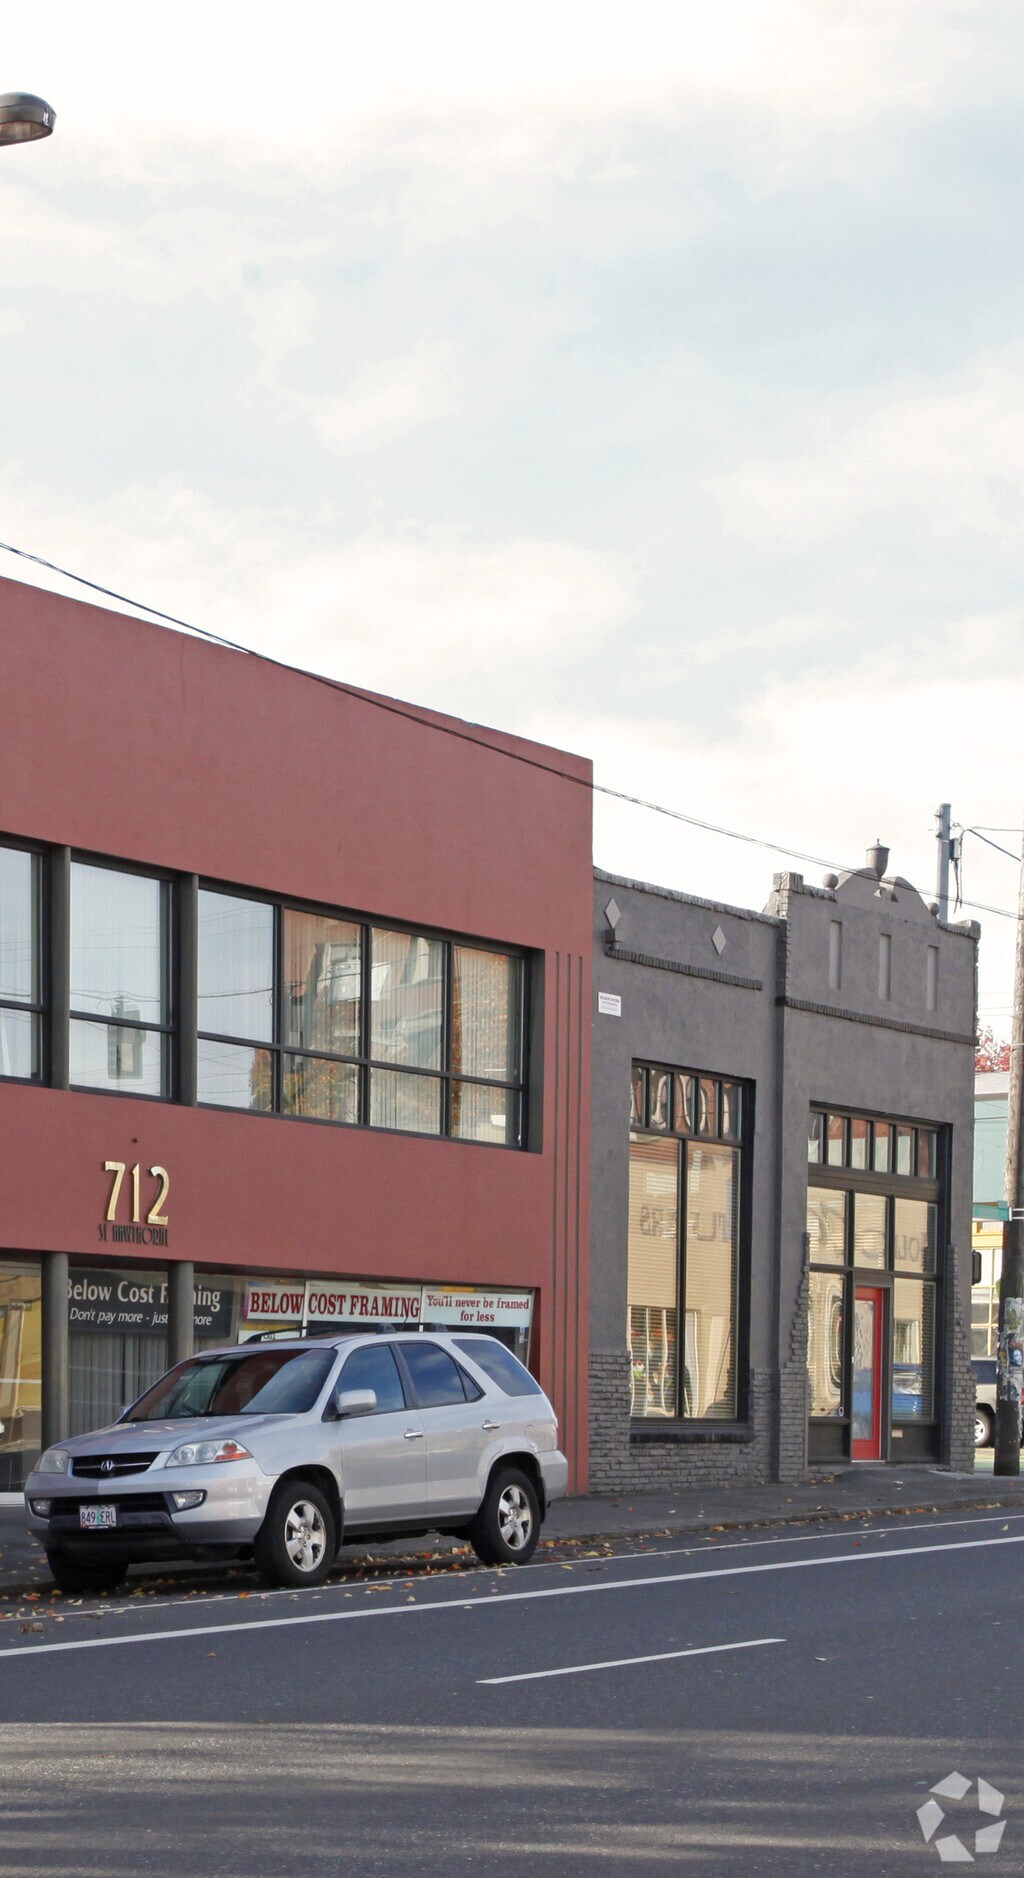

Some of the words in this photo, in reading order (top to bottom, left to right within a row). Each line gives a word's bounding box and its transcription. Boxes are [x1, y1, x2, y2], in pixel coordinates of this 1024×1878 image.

[104, 1160, 170, 1226] 712
[67, 1278, 113, 1302] Below
[117, 1280, 155, 1304] Cost
[249, 1292, 305, 1314] BELOW
[308, 1293, 347, 1315] COST
[349, 1295, 420, 1319] FRAMING
[426, 1295, 453, 1307] You'll
[455, 1299, 481, 1308] never
[483, 1297, 495, 1308] be
[497, 1298, 530, 1310] framed
[69, 1307, 96, 1321] Don't
[97, 1311, 117, 1324] pay
[118, 1312, 143, 1323] more
[460, 1310, 475, 1322] for
[476, 1310, 495, 1323] less
[81, 1511, 96, 1524] 849
[100, 1510, 116, 1524] ERL
